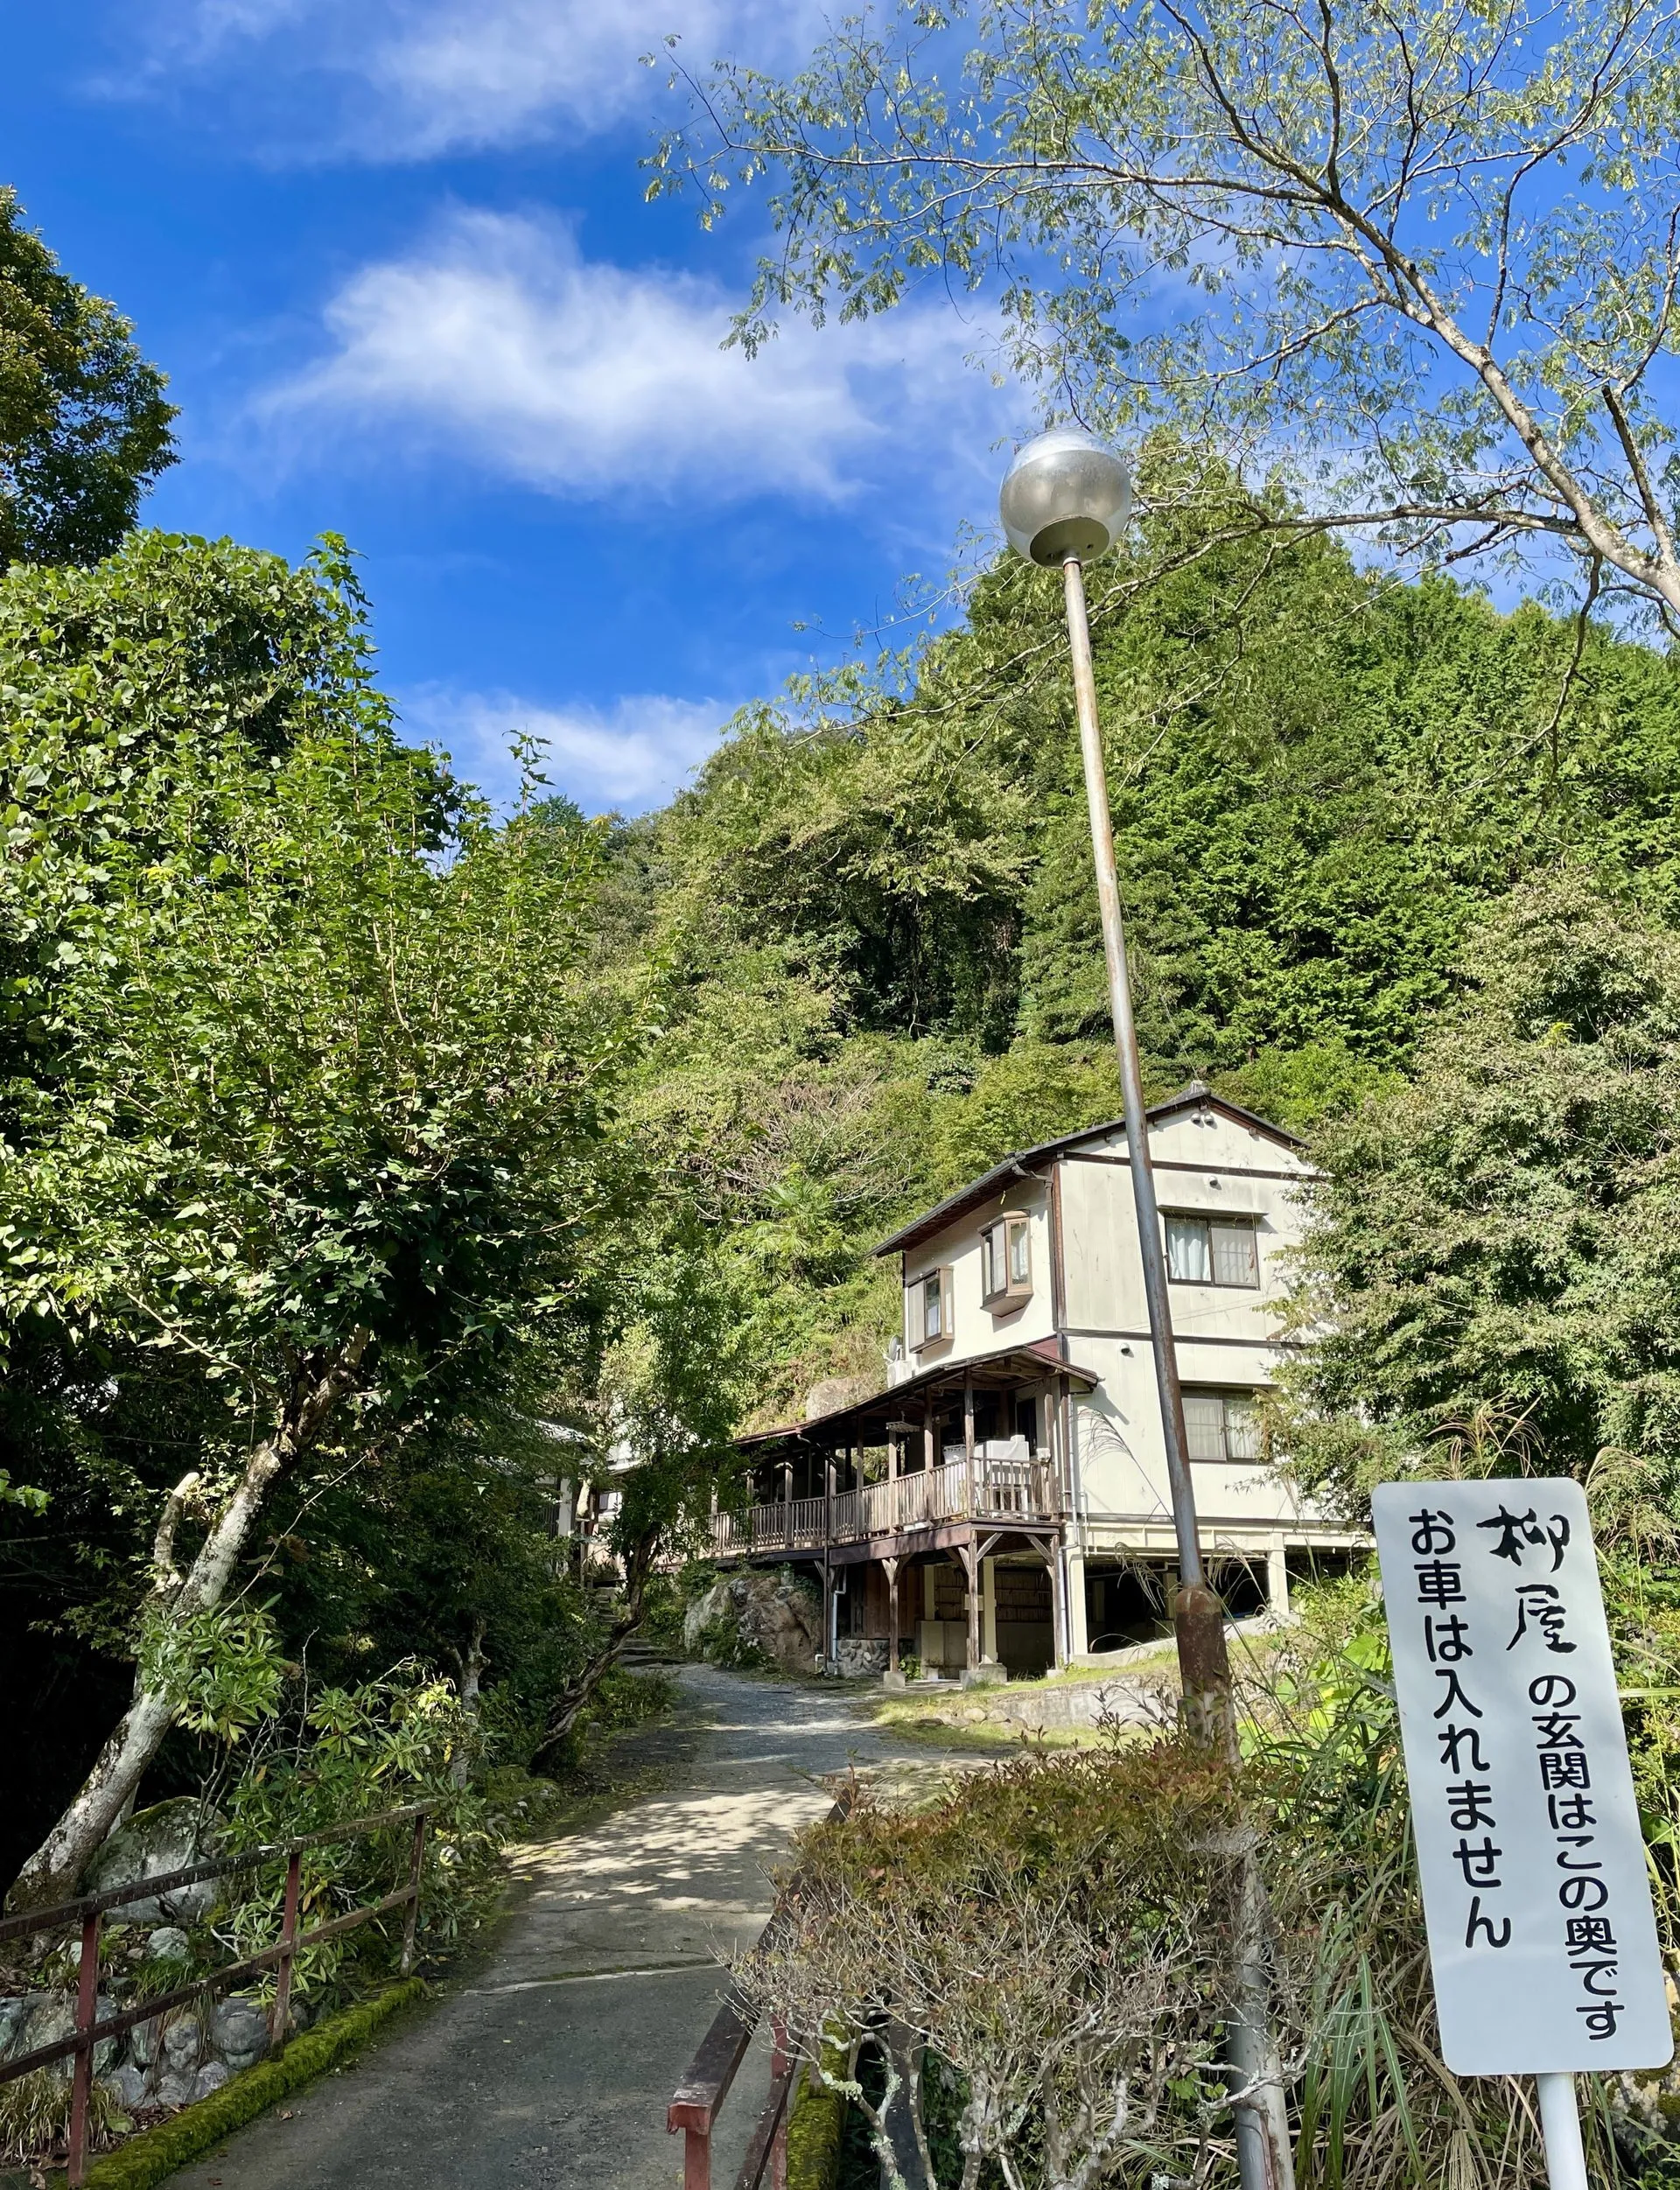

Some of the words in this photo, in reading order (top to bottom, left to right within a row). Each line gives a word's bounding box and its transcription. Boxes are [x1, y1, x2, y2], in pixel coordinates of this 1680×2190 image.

[1408, 1508, 1511, 1949] お車は入れません
